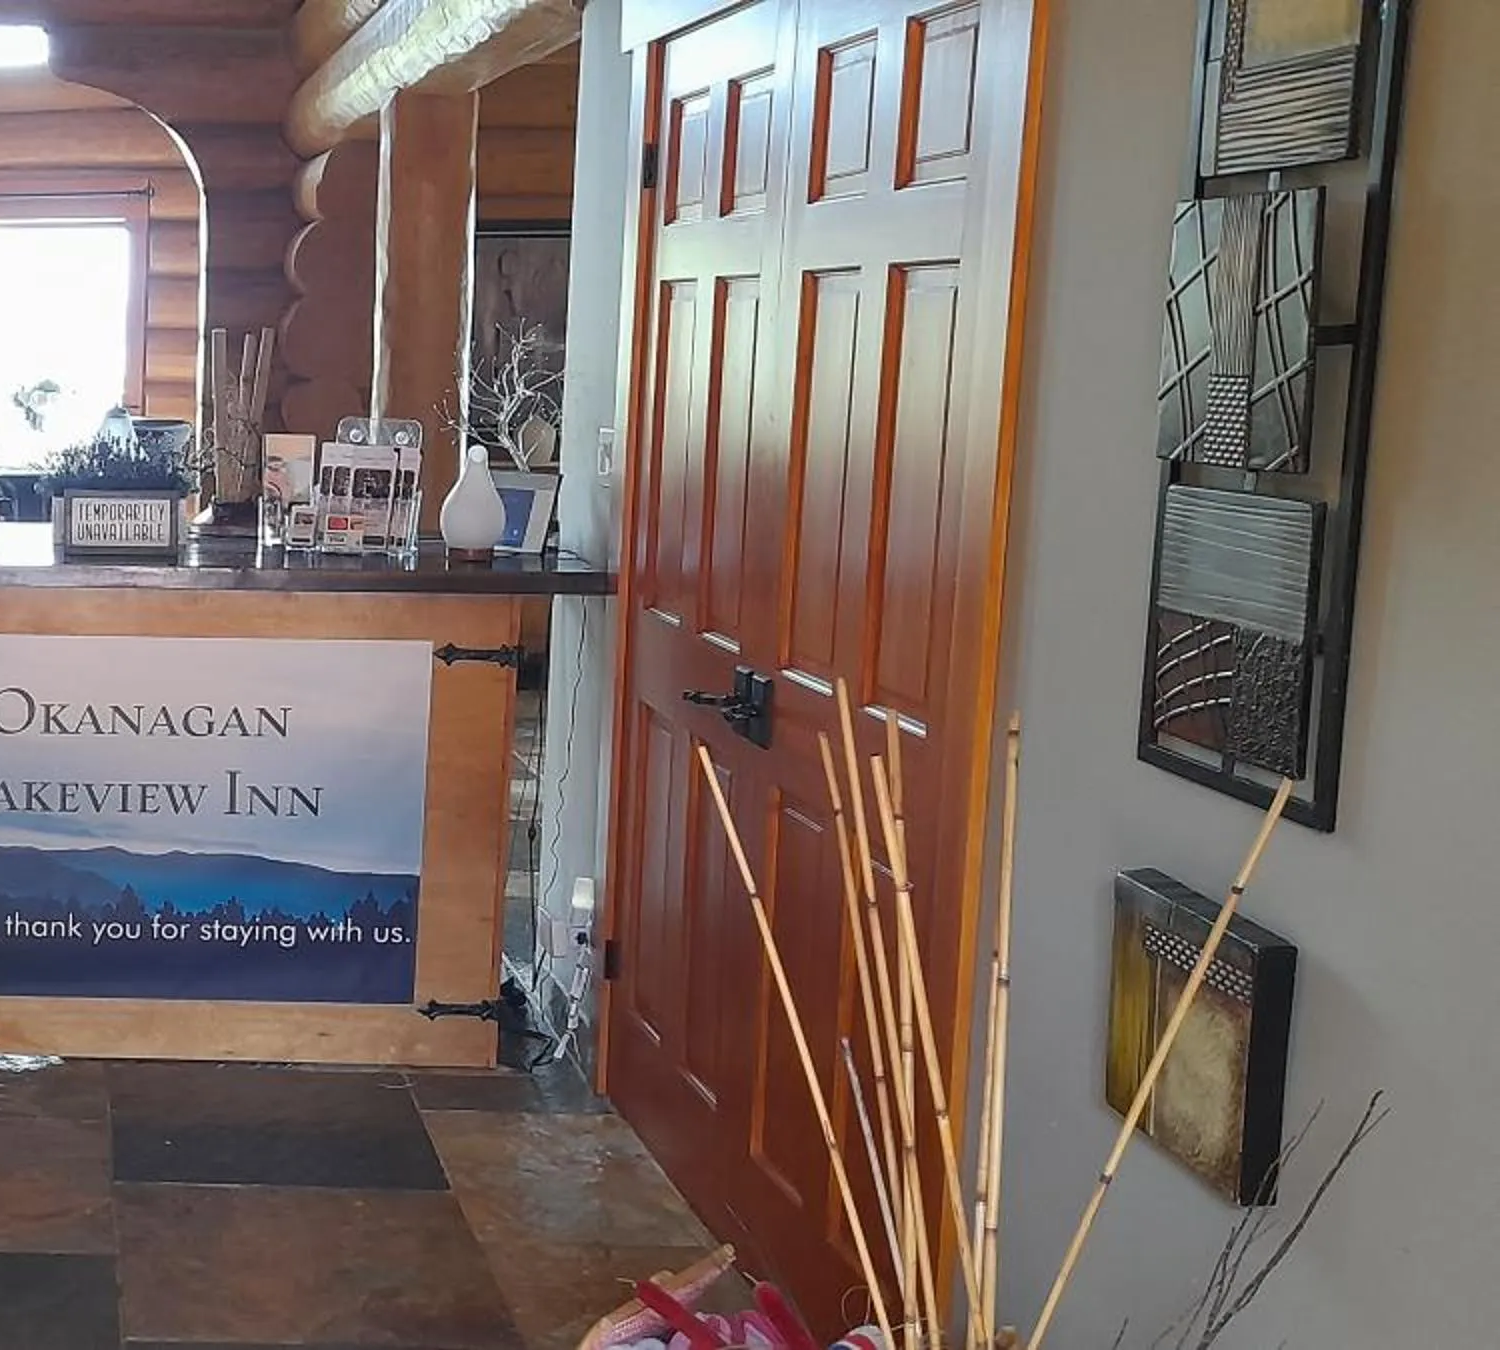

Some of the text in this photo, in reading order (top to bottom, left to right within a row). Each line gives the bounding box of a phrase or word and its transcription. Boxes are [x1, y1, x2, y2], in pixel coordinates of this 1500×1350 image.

[78, 503, 166, 521] TEMPORARILY
[77, 522, 166, 541] UNAVAILABLE
[4, 911, 83, 938] thank
[92, 918, 142, 945] you
[149, 912, 191, 941] for
[200, 916, 296, 948] staying
[307, 916, 363, 944] with
[372, 922, 412, 945] us.
